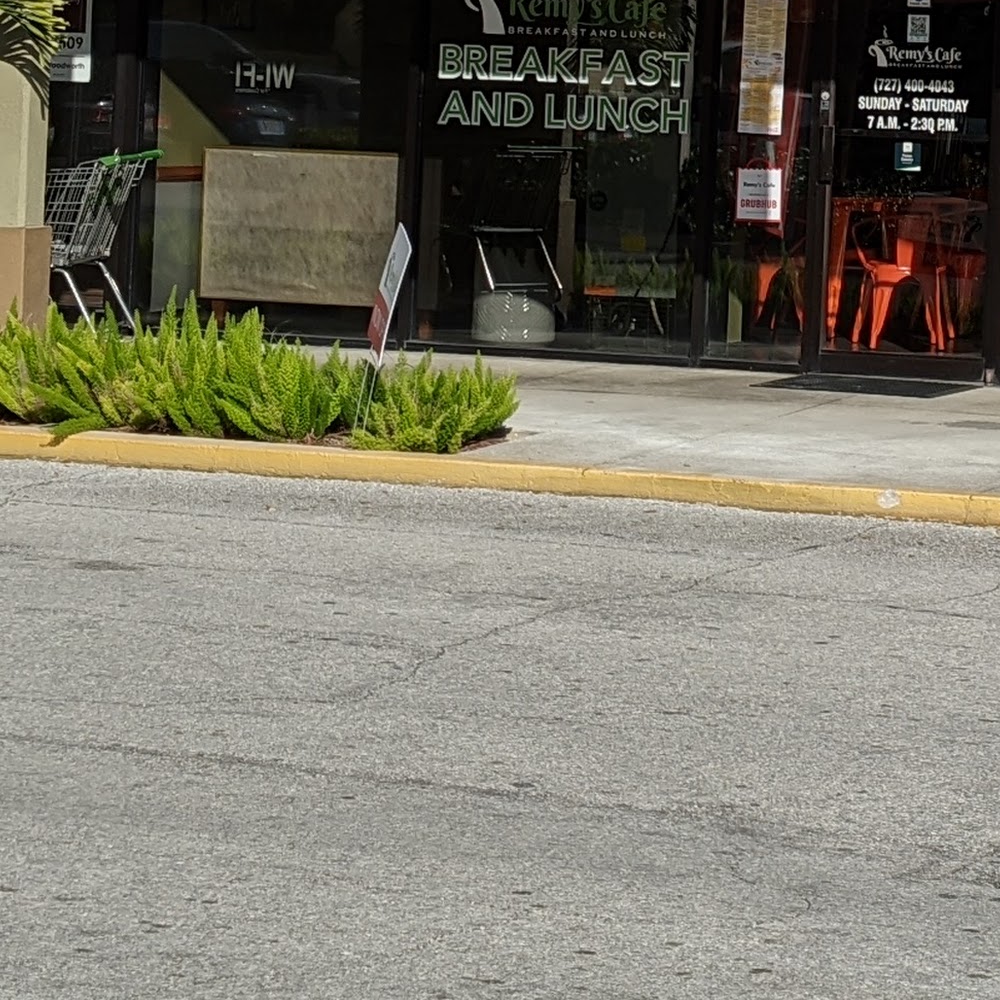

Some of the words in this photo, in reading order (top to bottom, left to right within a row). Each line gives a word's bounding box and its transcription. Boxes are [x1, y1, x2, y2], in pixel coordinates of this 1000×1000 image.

[507, 26, 588, 37] BREAKFAST
[590, 28, 618, 38] AND
[620, 29, 668, 40] LUNCH
[886, 45, 935, 64] Remy's
[934, 46, 962, 64] Cafe
[437, 42, 691, 88] BREAKFAST
[873, 78, 902, 94] (727)
[904, 79, 955, 93] 400-4043
[436, 89, 535, 128] AND
[544, 93, 690, 135] LUNCH
[858, 95, 903, 111] SUNDAY
[911, 97, 970, 113] SATURDAY
[867, 115, 875, 129] 7
[876, 115, 901, 130] A.M.
[937, 118, 959, 132] P.M.
[740, 198, 778, 210] GRUBHUB
